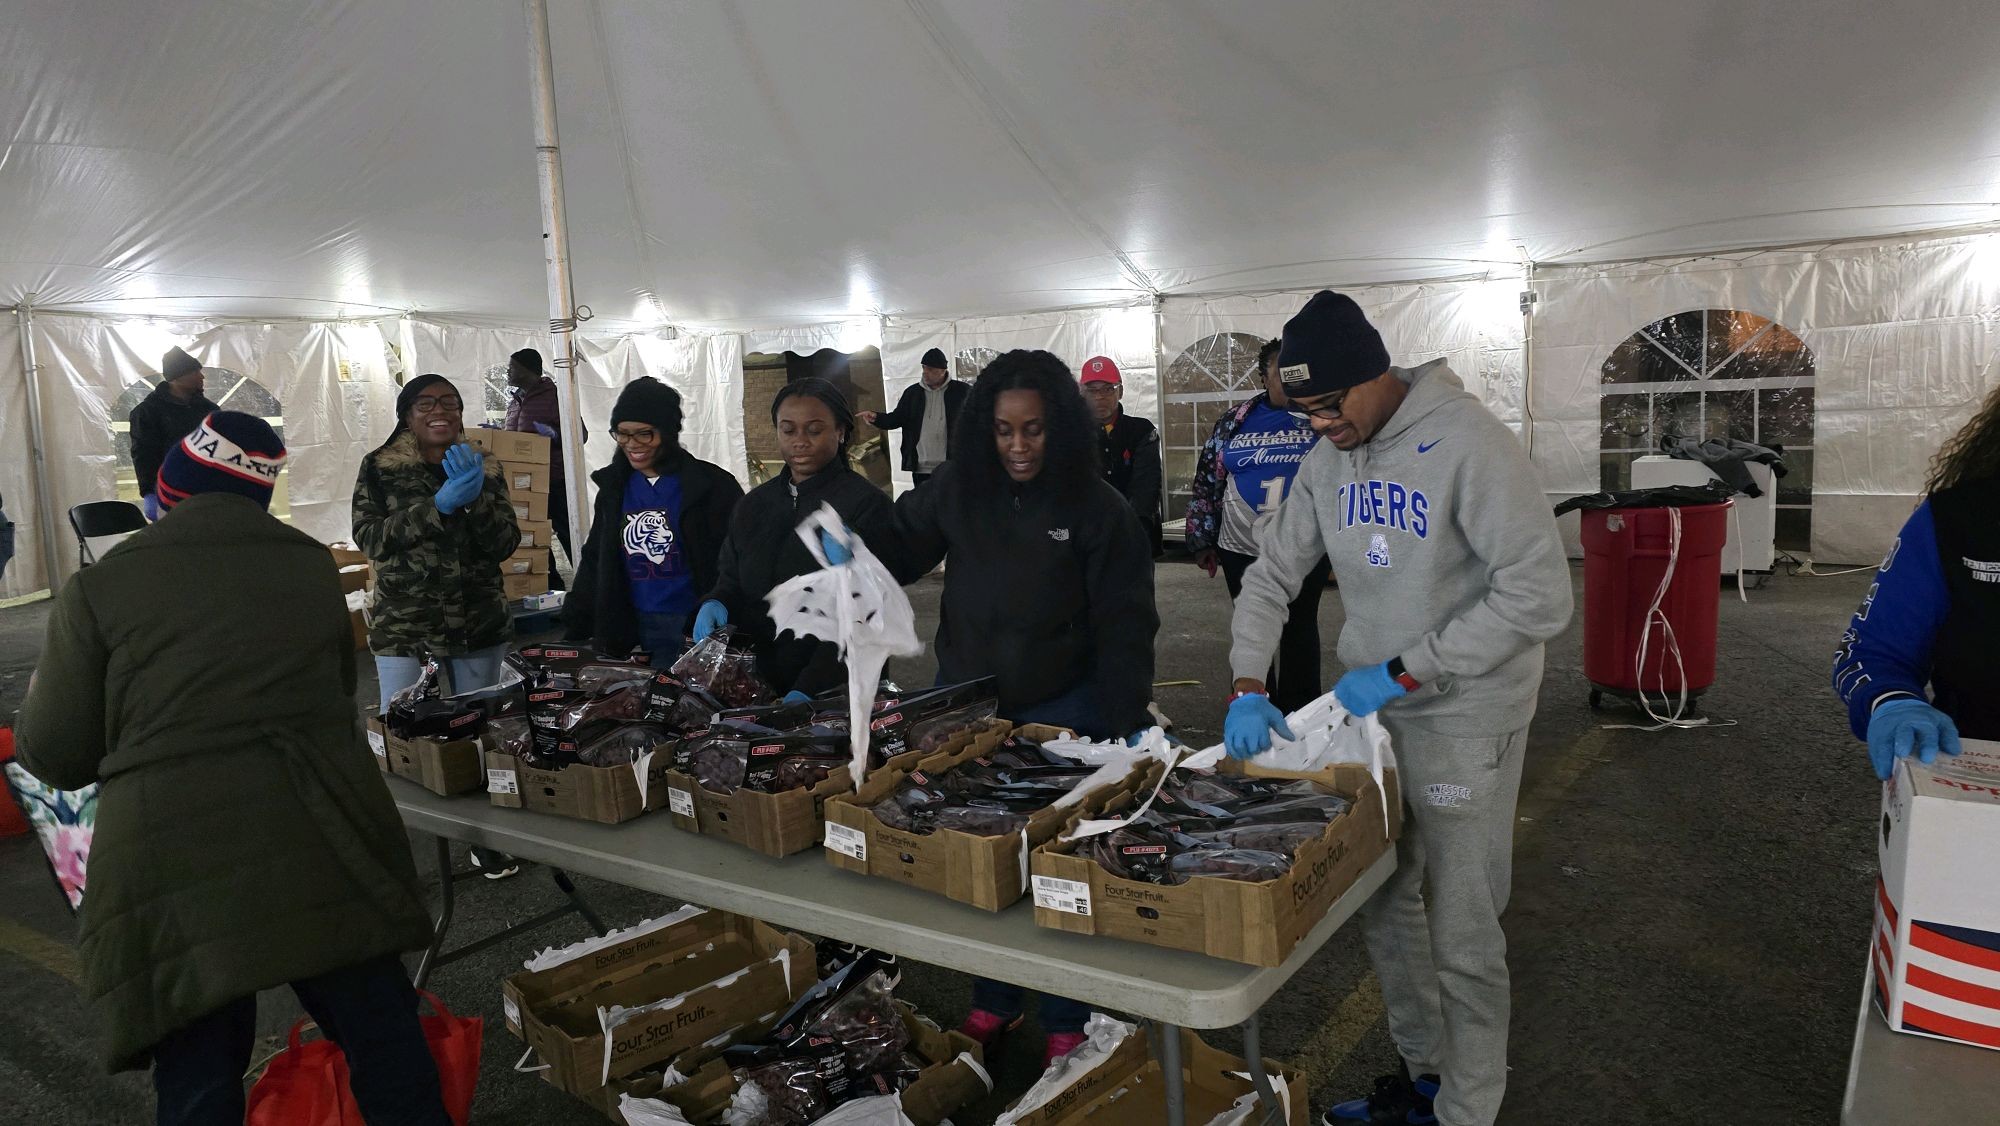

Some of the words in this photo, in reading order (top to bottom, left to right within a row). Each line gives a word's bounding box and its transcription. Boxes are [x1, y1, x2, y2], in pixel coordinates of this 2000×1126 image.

[1229, 436, 1313, 449] UNIVERSITY
[1232, 429, 1314, 441] DILLARD
[1335, 480, 1429, 540] TIGERS
[1292, 879, 1313, 906] Four
[1311, 856, 1329, 885] Star
[1328, 839, 1345, 869] Fruit
[1105, 884, 1125, 896] Four
[1126, 887, 1144, 899] Star
[1144, 890, 1164, 902] Fruit
[596, 952, 617, 967] Four
[617, 947, 635, 958] Star
[637, 938, 655, 952] Fruit
[611, 1034, 643, 1056] Four
[645, 1020, 674, 1042] Star
[676, 1005, 706, 1028] Fruit
[1062, 1087, 1077, 1105] Star
[1077, 1075, 1093, 1094] Fruit
